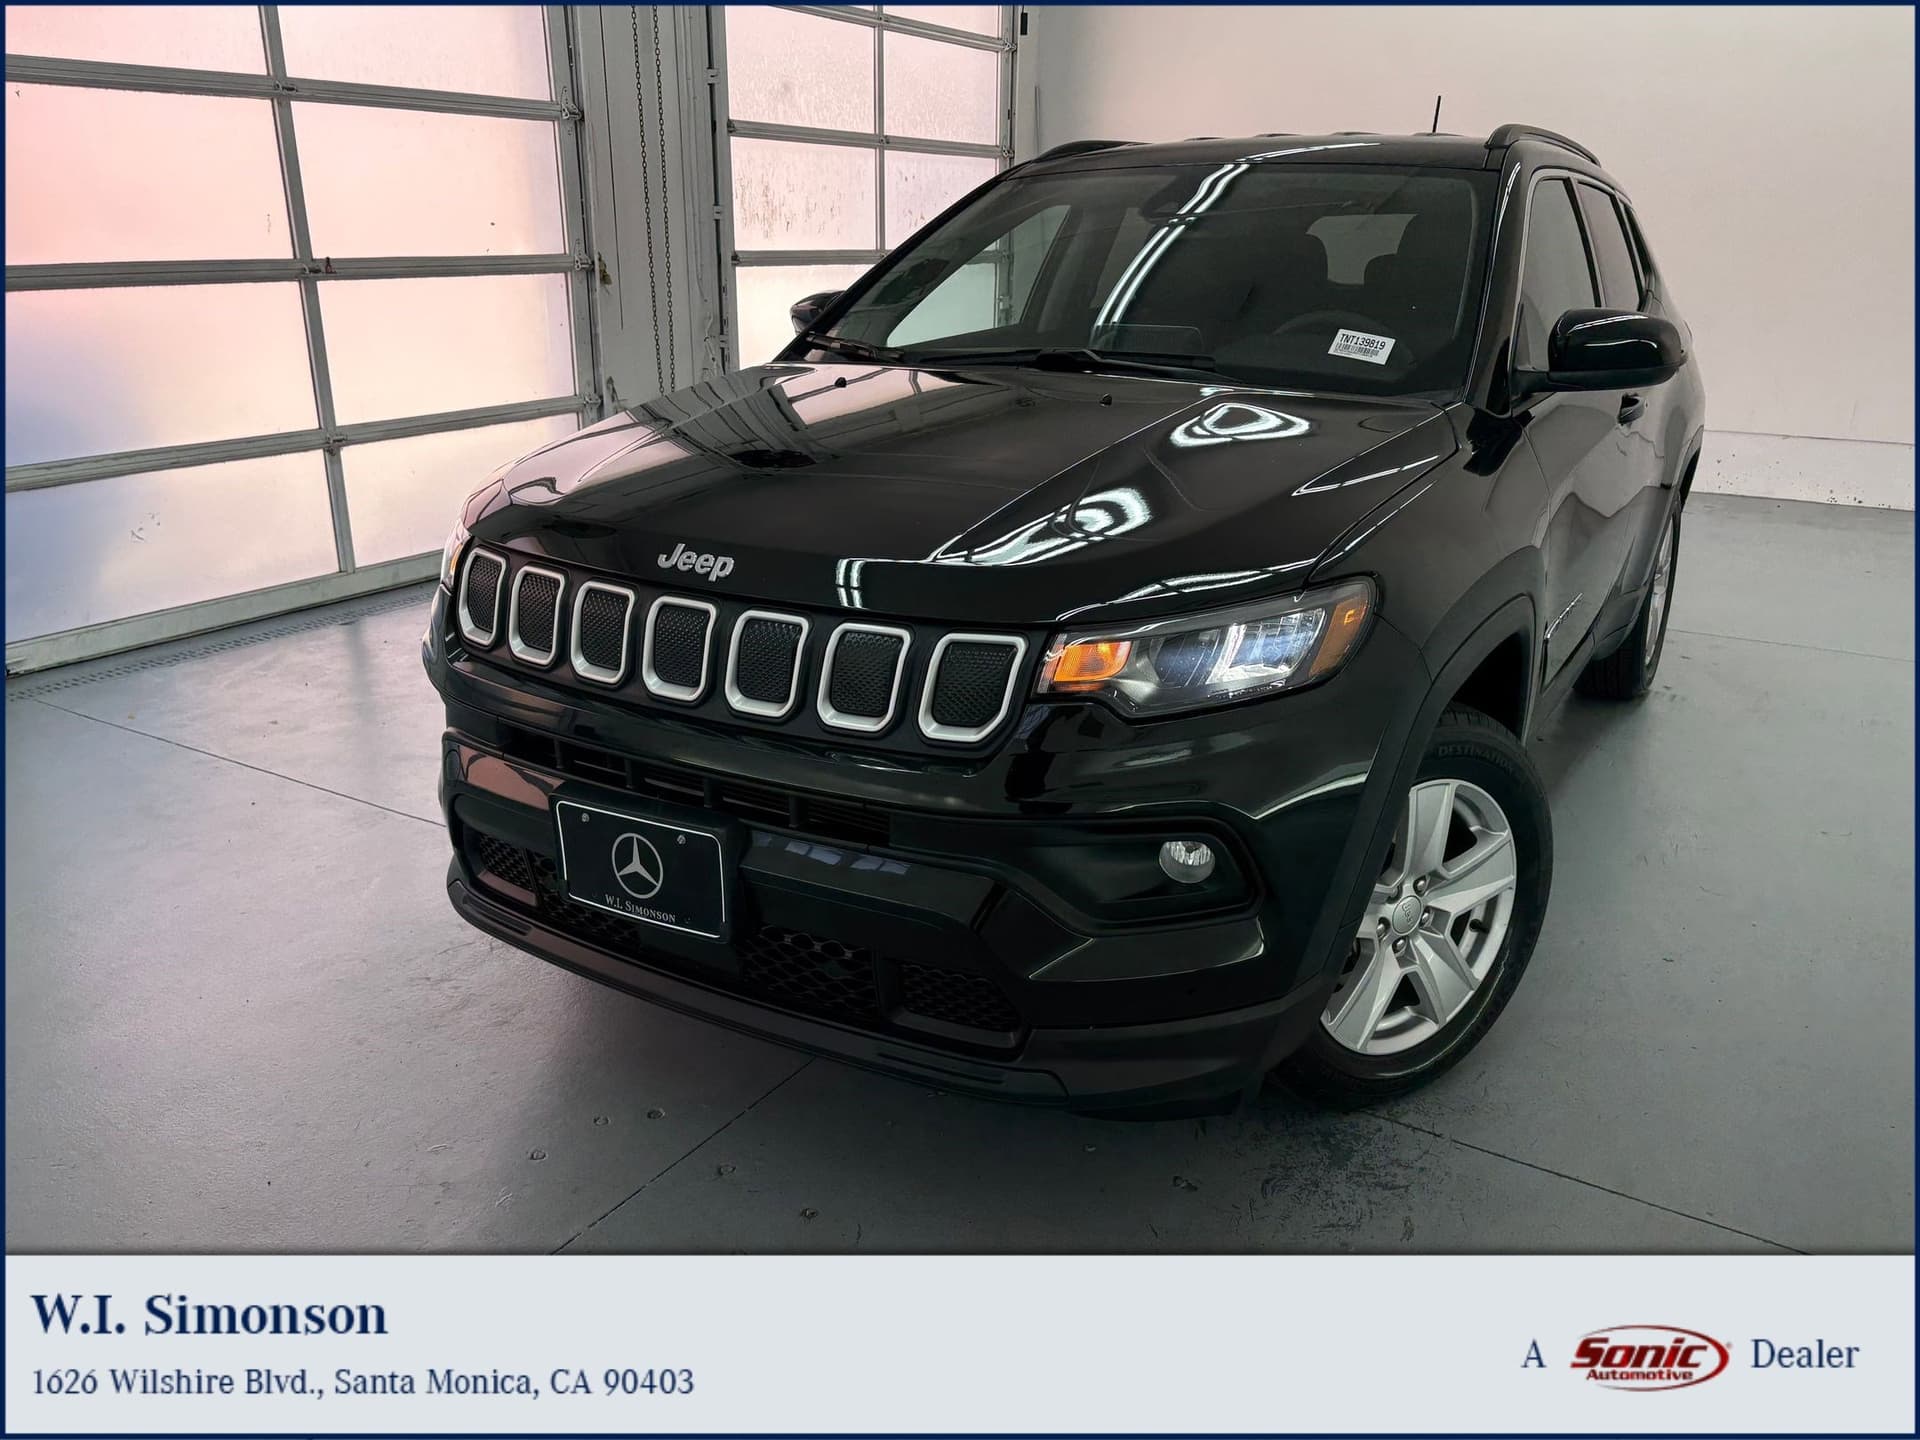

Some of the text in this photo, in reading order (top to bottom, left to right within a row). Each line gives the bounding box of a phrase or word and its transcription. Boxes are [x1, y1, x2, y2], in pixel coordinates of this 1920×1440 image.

[1340, 333, 1386, 351] TNT139819
[657, 543, 735, 582] Jeep
[605, 893, 624, 910] W.I.
